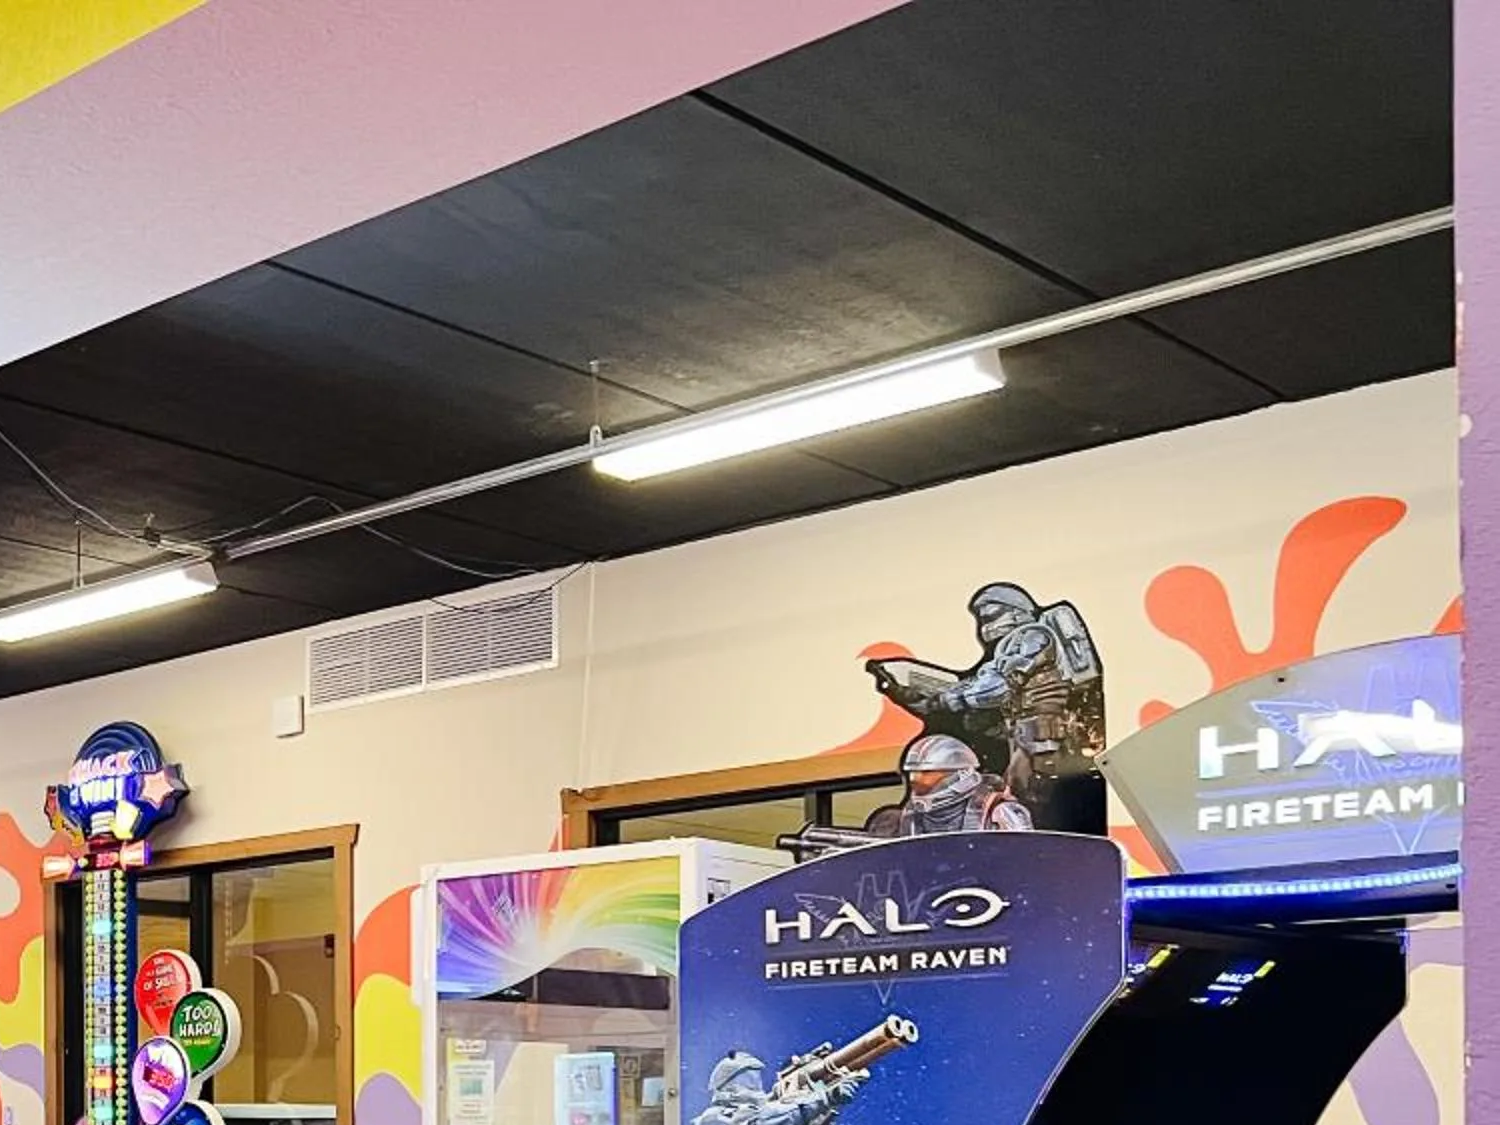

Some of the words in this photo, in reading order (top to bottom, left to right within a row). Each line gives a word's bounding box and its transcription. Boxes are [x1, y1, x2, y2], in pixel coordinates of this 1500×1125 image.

[1198, 699, 1464, 779] HAL
[1197, 783, 1434, 832] FIRETEAM
[765, 887, 1011, 944] HALO
[765, 955, 899, 980] FIRETEAM
[910, 946, 1008, 970] RAVEN
[181, 1005, 213, 1022] TOO
